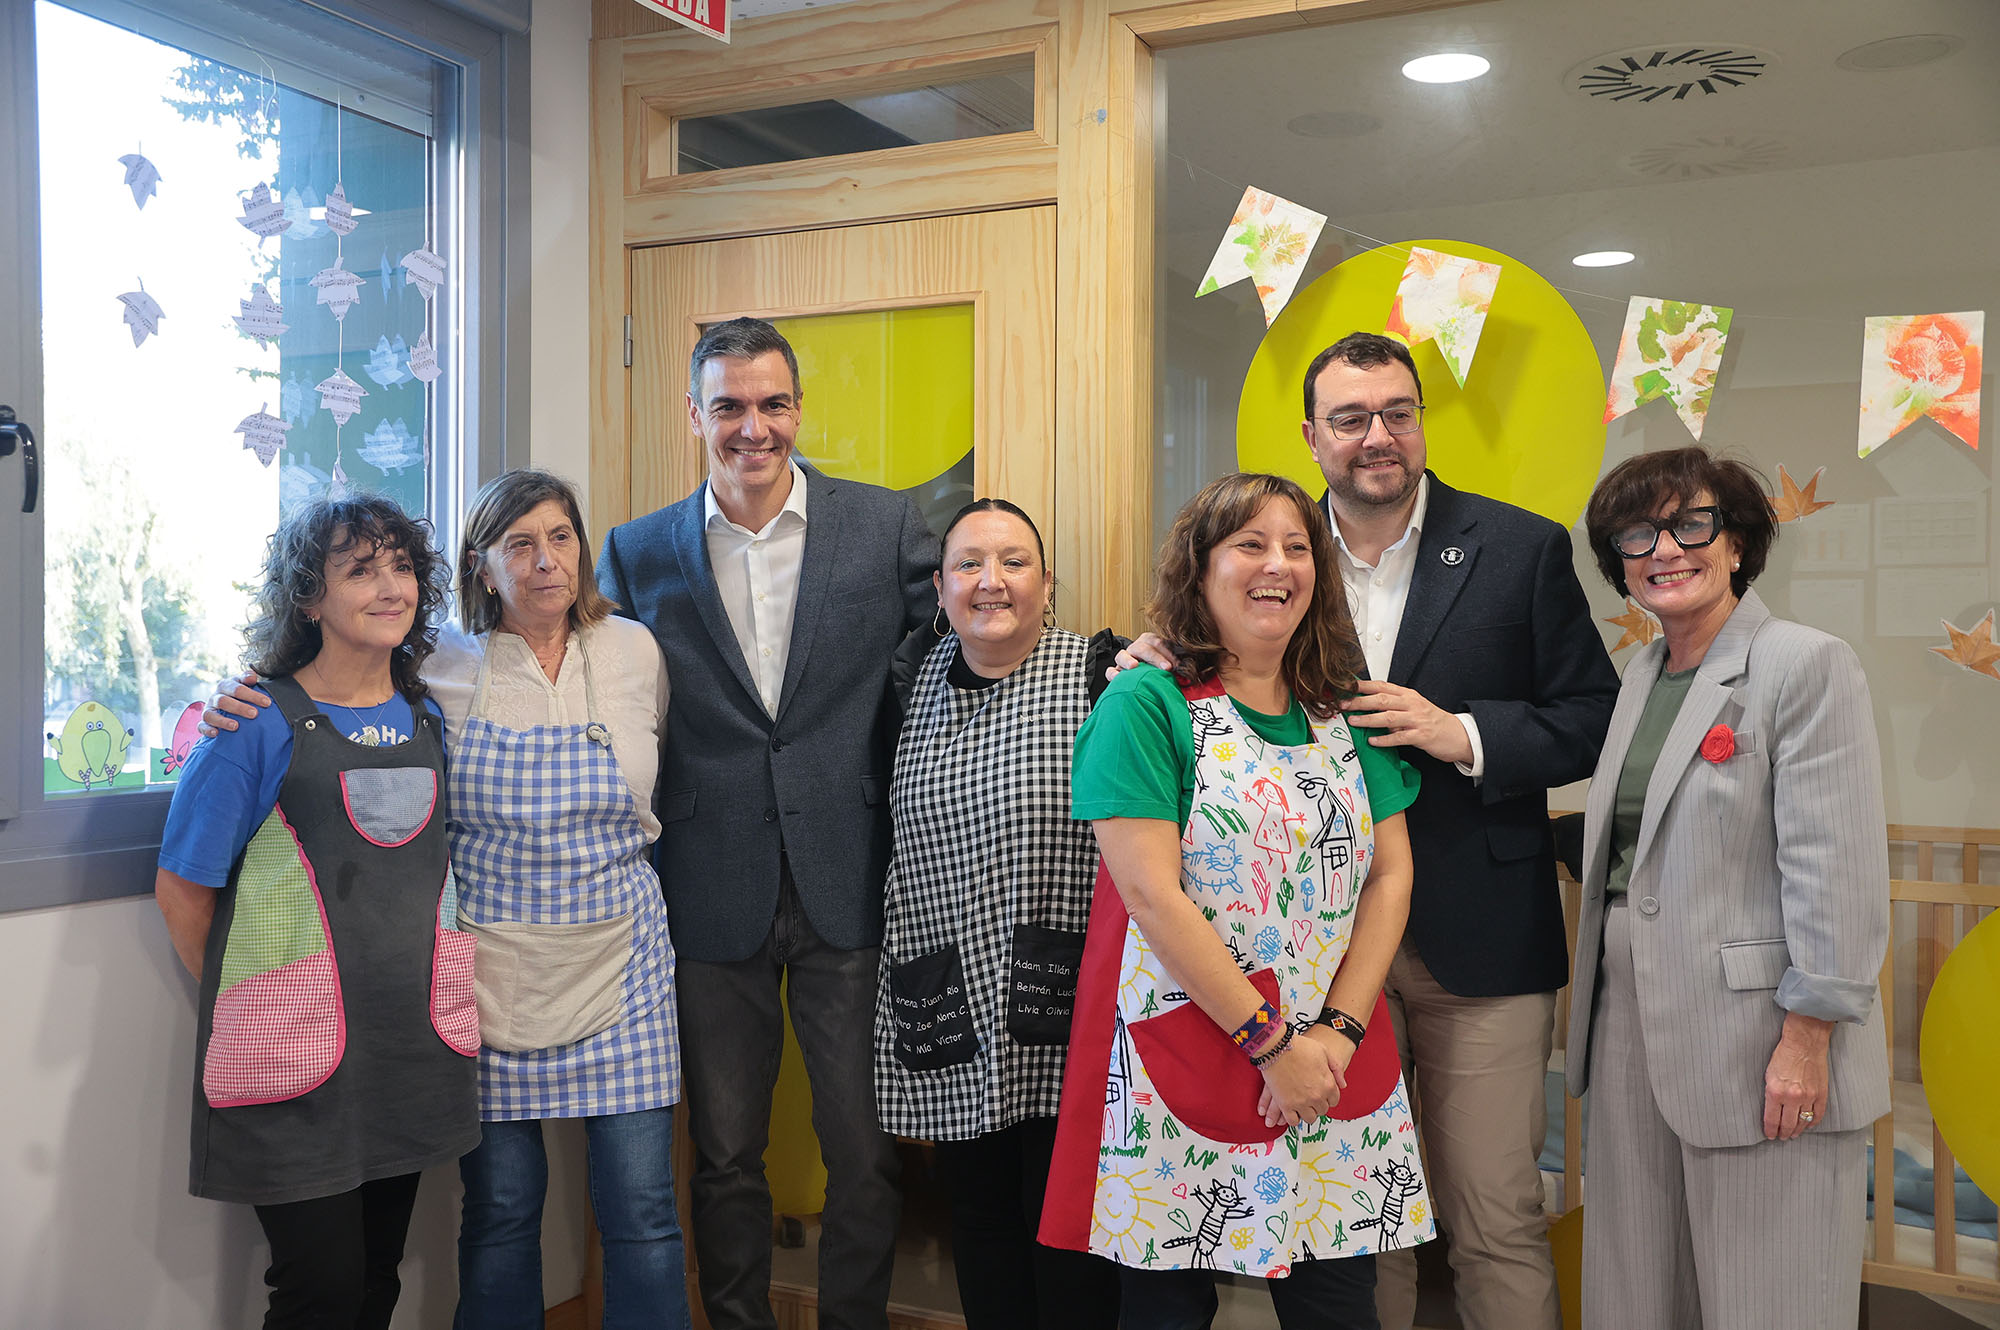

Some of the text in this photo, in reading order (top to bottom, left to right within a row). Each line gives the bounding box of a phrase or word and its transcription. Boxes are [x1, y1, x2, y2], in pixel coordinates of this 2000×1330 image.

[1013, 959, 1041, 972] Adam
[1016, 981, 1051, 995] Beltrán
[920, 994, 944, 1008] Juan
[916, 1021, 933, 1031] Zoe
[936, 1011, 957, 1024] Nora
[958, 1005, 969, 1015] C.
[1046, 1006, 1070, 1016] Olivia
[935, 1032, 963, 1046] Víctor
